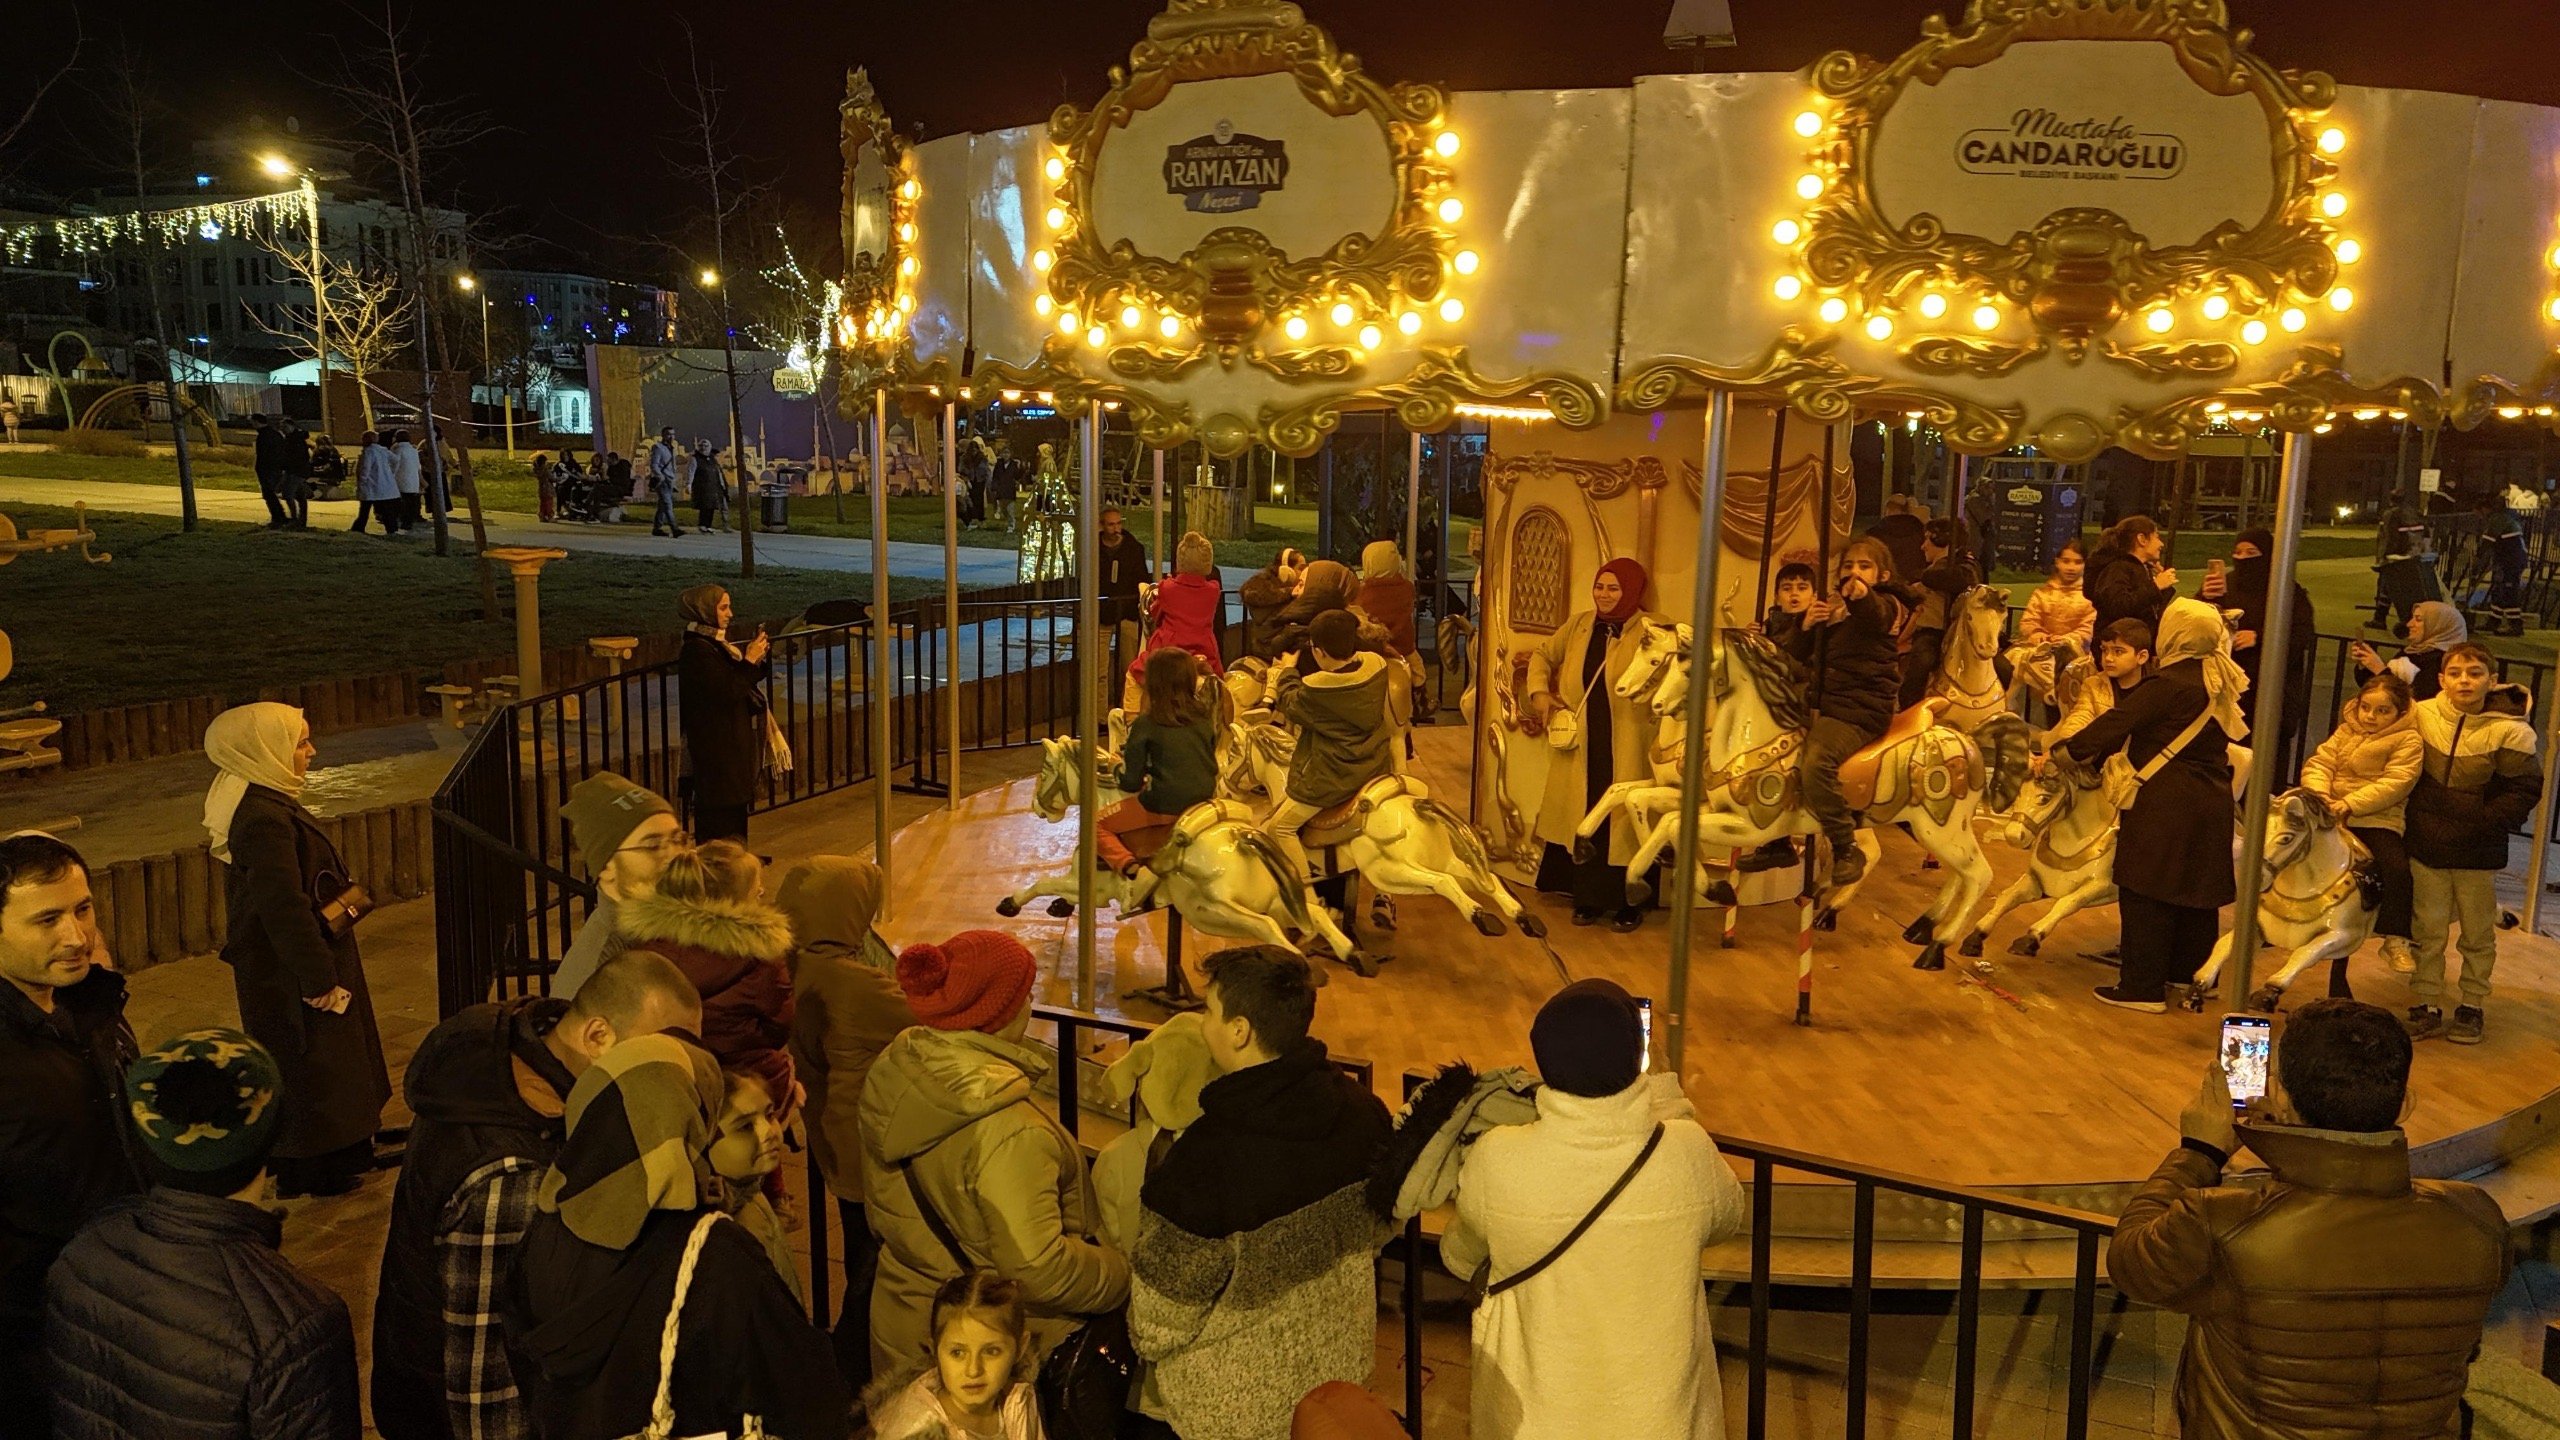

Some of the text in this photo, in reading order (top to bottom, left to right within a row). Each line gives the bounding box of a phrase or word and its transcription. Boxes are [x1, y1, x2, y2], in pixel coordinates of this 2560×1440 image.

[2010, 108, 2135, 148] Mustafa
[1963, 139, 2178, 169] CANDAROĞLU
[1170, 158, 1280, 188] RAMAZAN
[776, 377, 811, 390] RAMAZ
